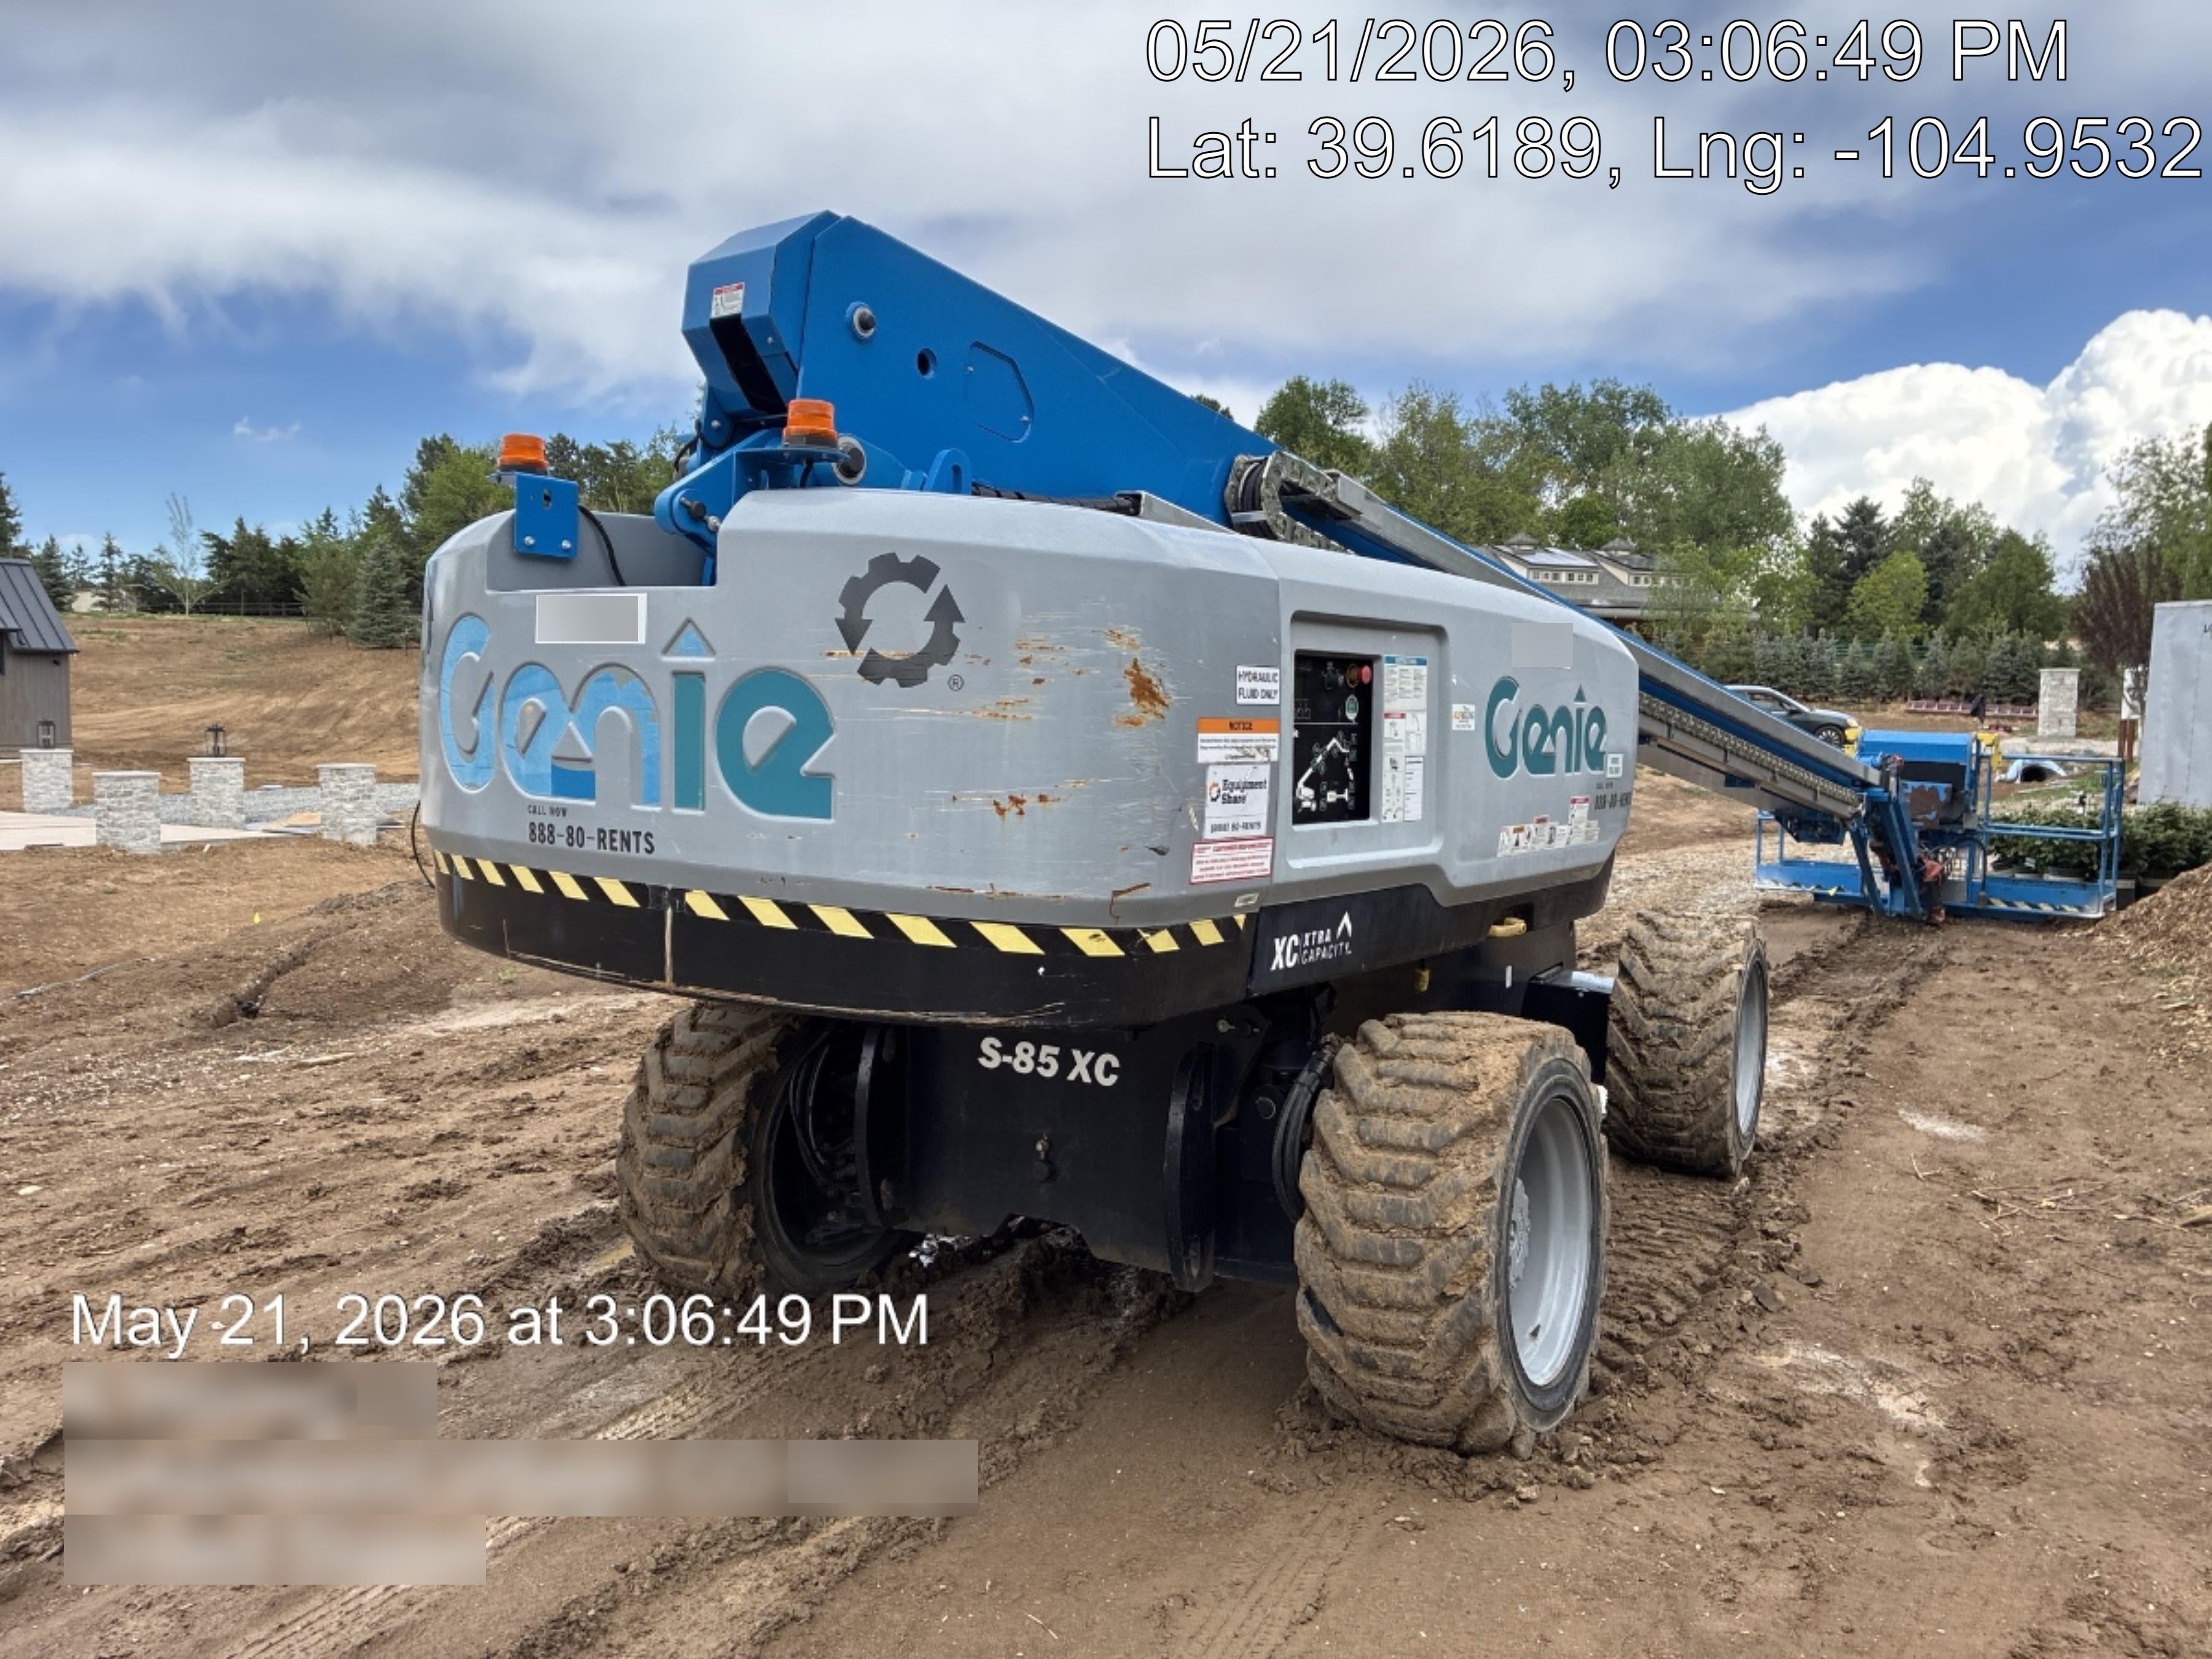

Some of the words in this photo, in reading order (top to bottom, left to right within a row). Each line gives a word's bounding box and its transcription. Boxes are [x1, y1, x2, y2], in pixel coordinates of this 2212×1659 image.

[1238, 670, 1278, 683] HYDRAULIC
[1238, 686, 1259, 699] FLUID
[1261, 688, 1278, 700] ONLY
[439, 613, 836, 824] Genie
[1229, 721, 1253, 731] NOTICE
[1485, 676, 1607, 779] Genie
[1222, 779, 1267, 793] Equipment
[1222, 793, 1247, 805] Share
[527, 804, 546, 816] CALL
[549, 806, 567, 817] NOW
[528, 821, 656, 855] 888-80-RENTS
[1270, 933, 1299, 971] XC
[1303, 928, 1332, 947] XTRA
[1301, 941, 1352, 965] CAPACITY
[977, 1035, 1061, 1078] S-85
[1066, 1048, 1121, 1087] XC
